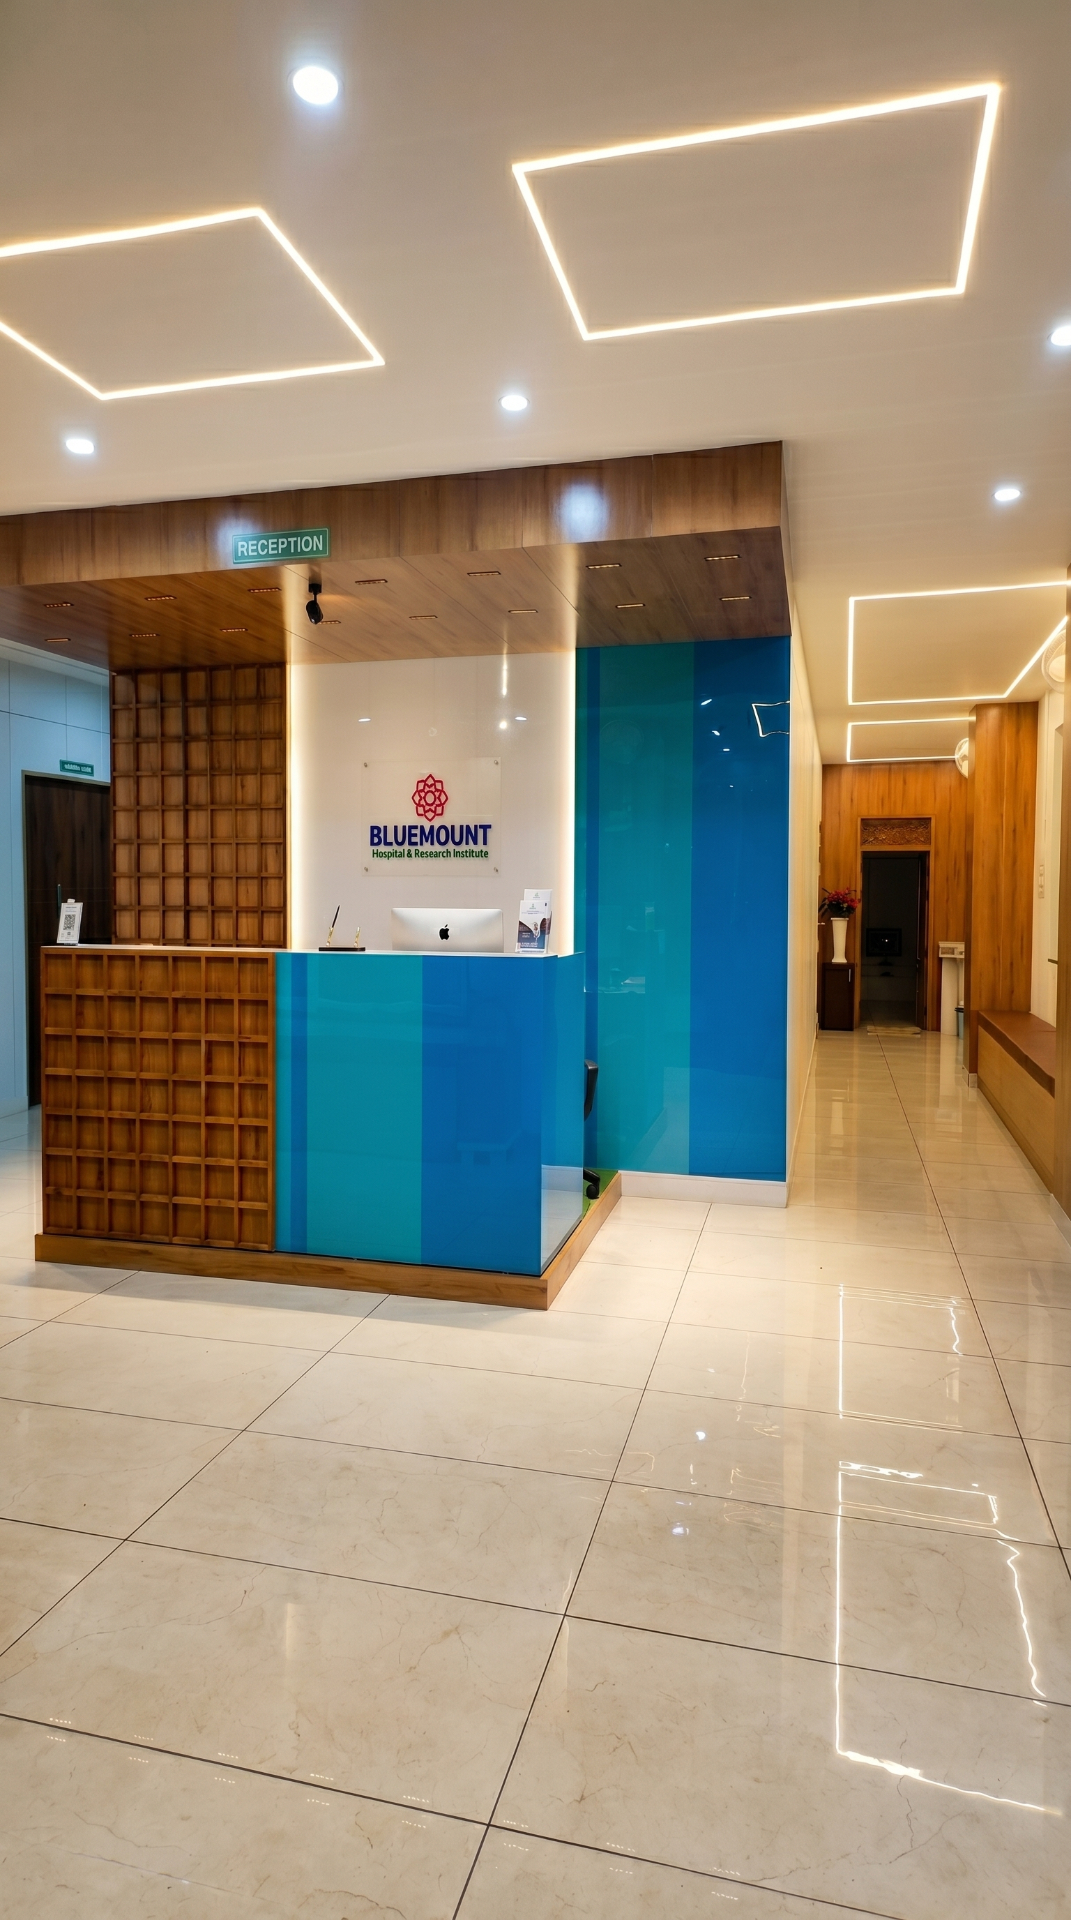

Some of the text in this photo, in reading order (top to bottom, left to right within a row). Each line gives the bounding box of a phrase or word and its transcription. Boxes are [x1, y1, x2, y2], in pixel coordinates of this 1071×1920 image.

[237, 534, 323, 557] RECEPTION
[369, 824, 492, 847] BLUEMOUNT
[372, 848, 489, 860] Hospital & Research Institute
